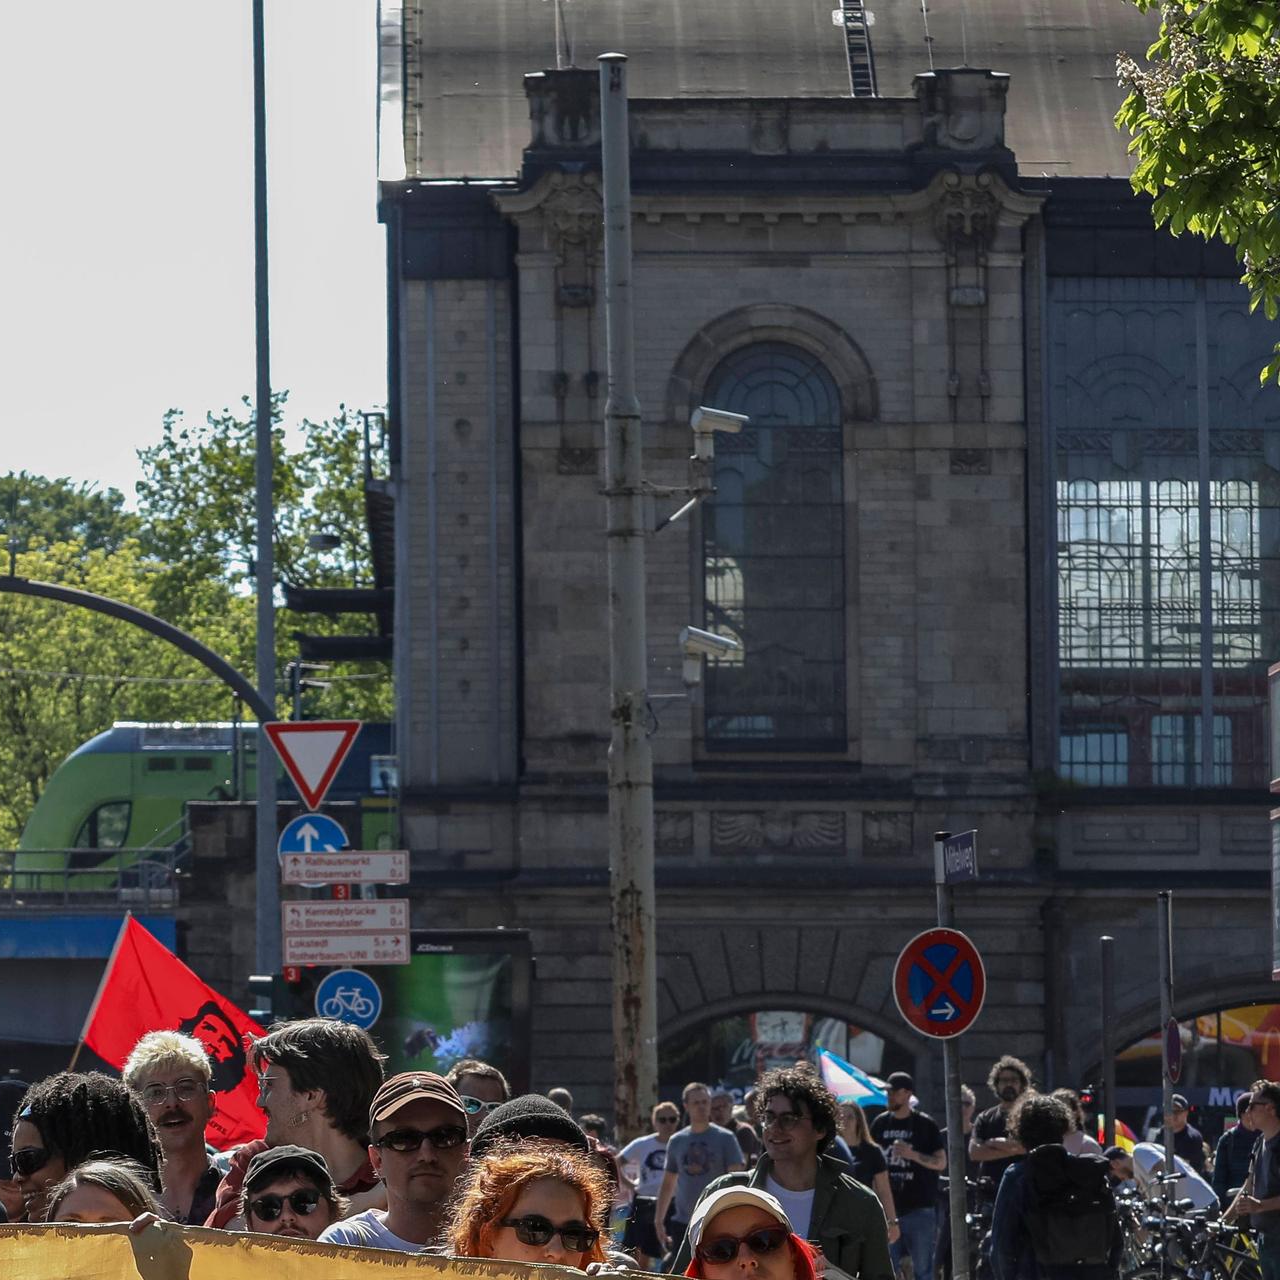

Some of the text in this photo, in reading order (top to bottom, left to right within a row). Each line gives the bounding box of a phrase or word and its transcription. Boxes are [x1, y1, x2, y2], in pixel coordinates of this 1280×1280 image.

[304, 856, 371, 866] Rathausmarkt
[304, 868, 363, 879] Gänsemarkt
[304, 907, 377, 918] Kennedybrücke
[289, 938, 329, 948] Lokstedt
